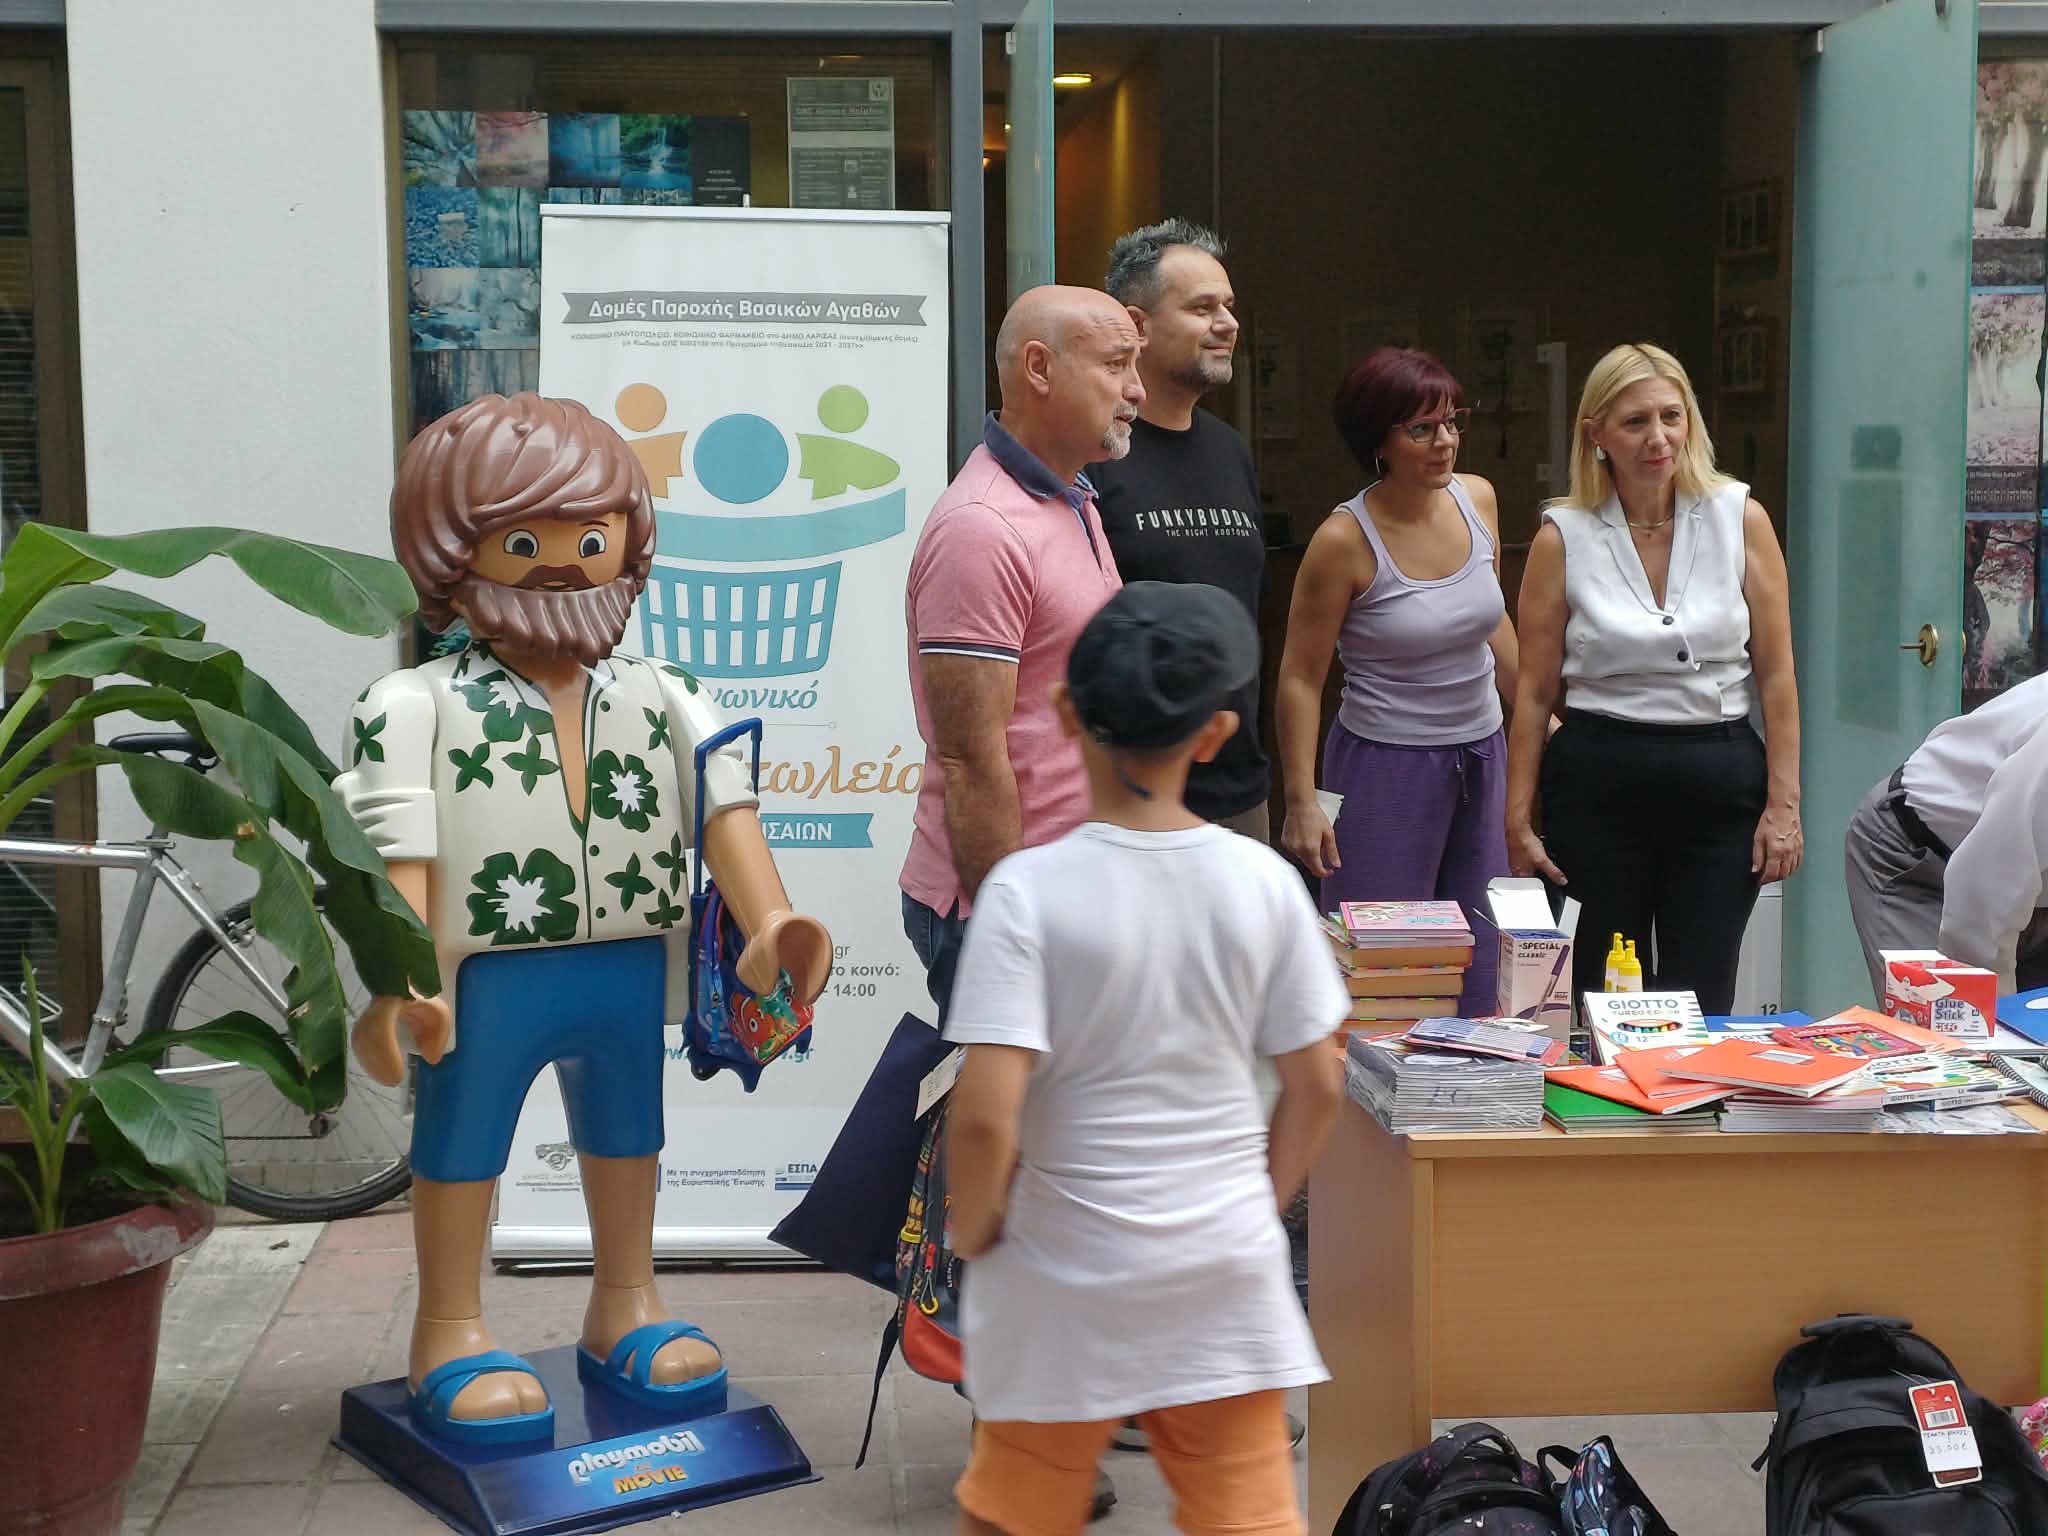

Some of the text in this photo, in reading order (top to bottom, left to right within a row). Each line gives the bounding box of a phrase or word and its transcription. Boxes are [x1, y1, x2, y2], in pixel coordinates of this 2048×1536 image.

[589, 298, 901, 322] Δομές Παροχής Βασικών Αγαθών
[851, 963, 900, 976] κοινό:
[834, 983, 876, 997] 14:00
[1607, 999, 1678, 1009] GIOTTO
[1936, 999, 1965, 1008] Glue
[1761, 1004, 1777, 1016] 12
[1935, 1009, 1966, 1020] Stick
[788, 1163, 817, 1173] ΕΣΠΑ
[568, 1431, 704, 1483] playmobil
[614, 1467, 688, 1494] MOVIE
